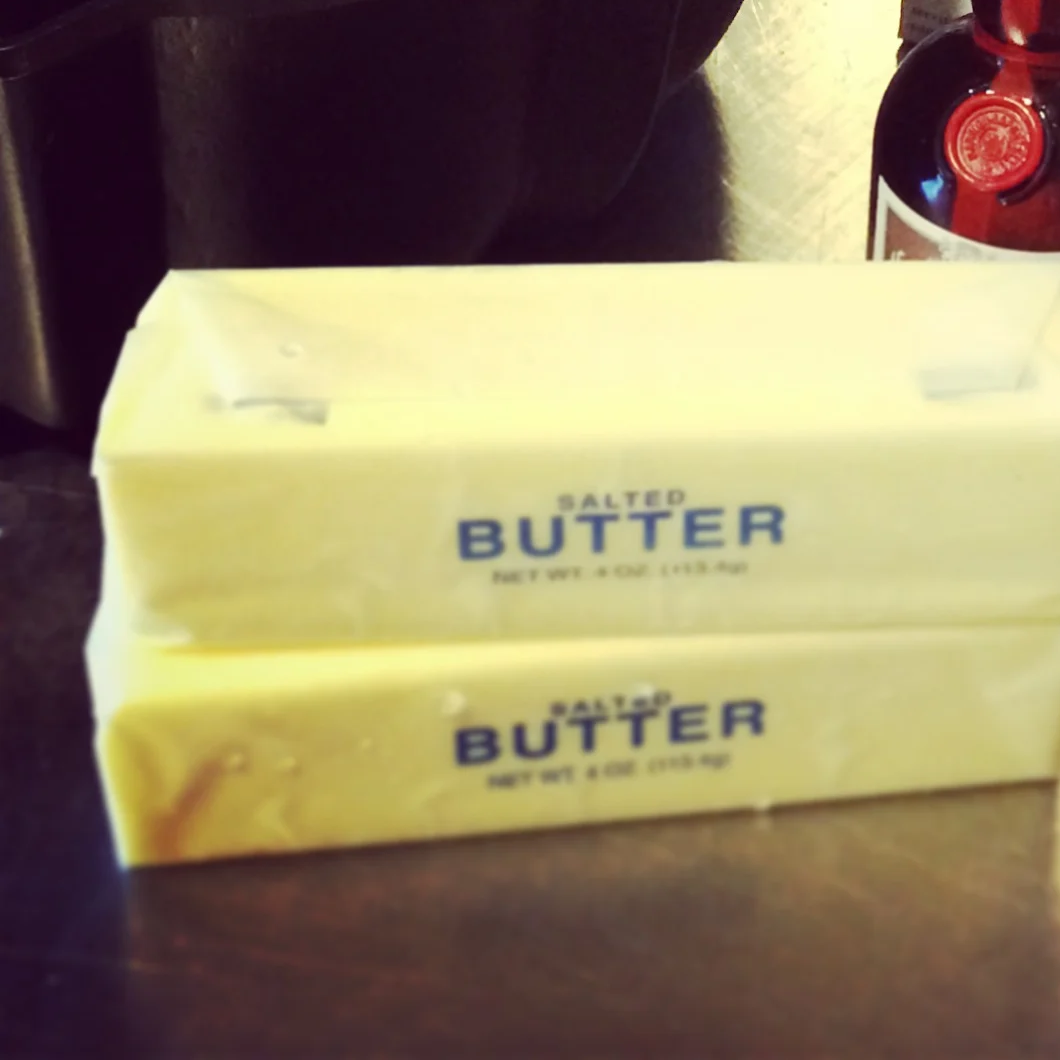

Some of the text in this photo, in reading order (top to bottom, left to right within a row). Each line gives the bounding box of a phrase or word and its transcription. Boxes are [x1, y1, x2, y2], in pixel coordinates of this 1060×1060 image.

[557, 488, 686, 512] SALTED
[456, 505, 787, 561] BUTTER
[453, 700, 766, 767] BUTTER
